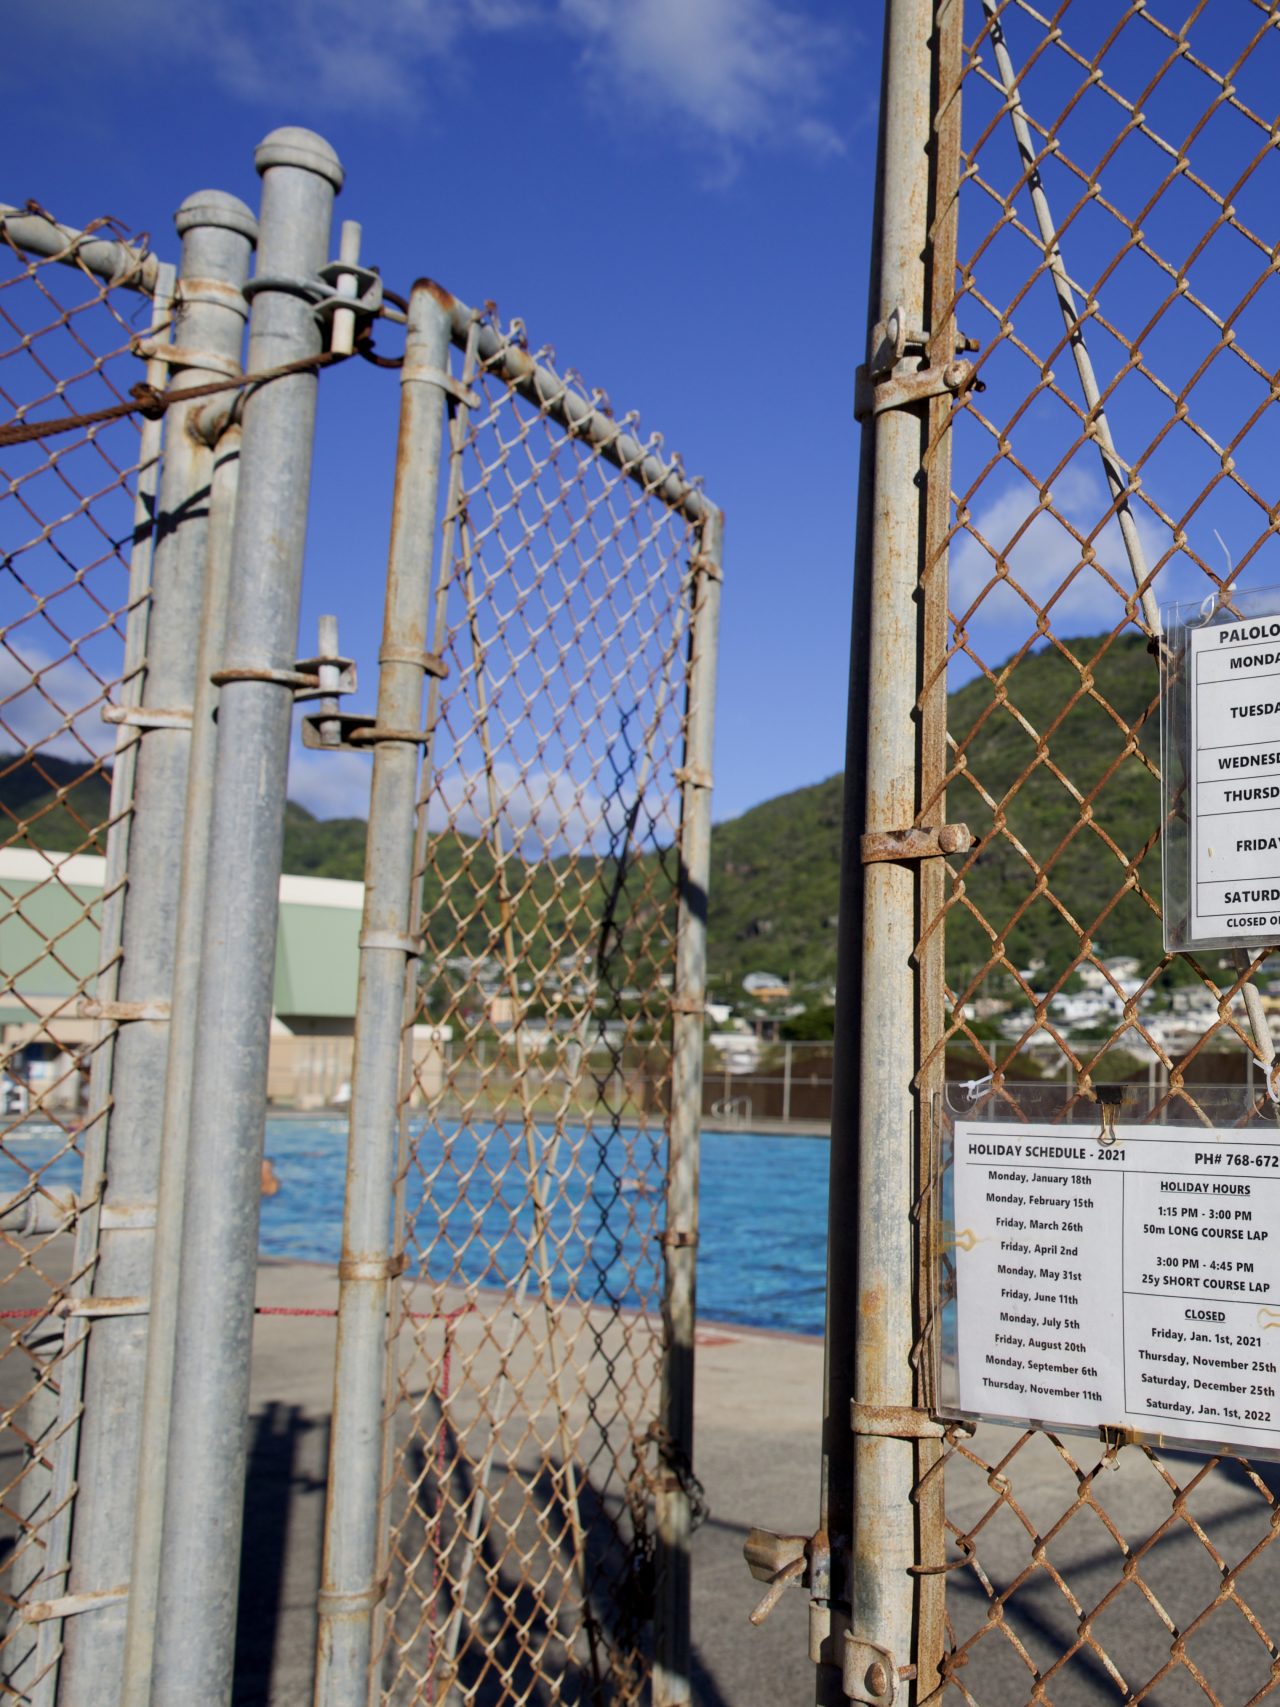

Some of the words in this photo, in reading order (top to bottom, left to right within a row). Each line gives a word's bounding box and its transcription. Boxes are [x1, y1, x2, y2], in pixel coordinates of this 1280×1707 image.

[1220, 623, 1280, 644] PALOLO
[1226, 917, 1267, 928] CLOSED
[969, 1144, 1022, 1156] HOLIDAY
[1025, 1146, 1086, 1160] SCHEDULE
[1098, 1149, 1125, 1161] 2021
[1195, 1153, 1222, 1165] PH#
[988, 1171, 1029, 1184] Monday,
[1031, 1173, 1069, 1187] January
[1071, 1175, 1092, 1185] 18th
[1160, 1181, 1210, 1193] HOLIDAY
[1212, 1184, 1251, 1192] HOURS
[1158, 1206, 1178, 1217] 1:15
[1181, 1207, 1198, 1218] PM
[1209, 1209, 1232, 1220] 3:00
[1235, 1210, 1252, 1221] PM
[1143, 1224, 1165, 1235] 50m
[1168, 1225, 1199, 1237] LONG
[1201, 1227, 1244, 1240] COURSE
[1247, 1230, 1269, 1241] LAP
[1156, 1256, 1179, 1267] 3:00
[1182, 1258, 1199, 1269] PM
[1209, 1260, 1233, 1272] 4:45
[1236, 1262, 1254, 1273] PM
[1142, 1273, 1160, 1287] 25y
[1163, 1275, 1201, 1287] SHORT
[1203, 1278, 1246, 1291] COURSE
[1249, 1282, 1271, 1293] LAP
[1001, 1288, 1031, 1303] Friday,
[1034, 1292, 1056, 1303] June
[1059, 1294, 1078, 1305] 11th
[1184, 1309, 1226, 1322] CLOSED
[1152, 1327, 1187, 1343] Friday,
[1190, 1331, 1212, 1343] Jan.
[1214, 1334, 1233, 1346] 1st,
[1236, 1335, 1261, 1347] 2021
[1138, 1349, 1189, 1366] Thursday,
[1193, 1355, 1249, 1370] November
[1252, 1361, 1277, 1373] 25th
[982, 1377, 1027, 1394] Thursday,
[1030, 1384, 1080, 1398] November
[1082, 1390, 1102, 1402] 11th
[1141, 1373, 1190, 1390] Saturday,
[1193, 1379, 1247, 1394] December
[1250, 1385, 1275, 1397] 25th
[1146, 1398, 1195, 1415] Saturday,
[1198, 1404, 1220, 1416] Jan.
[1223, 1407, 1241, 1420] 1st,
[1244, 1410, 1271, 1422] 2022
